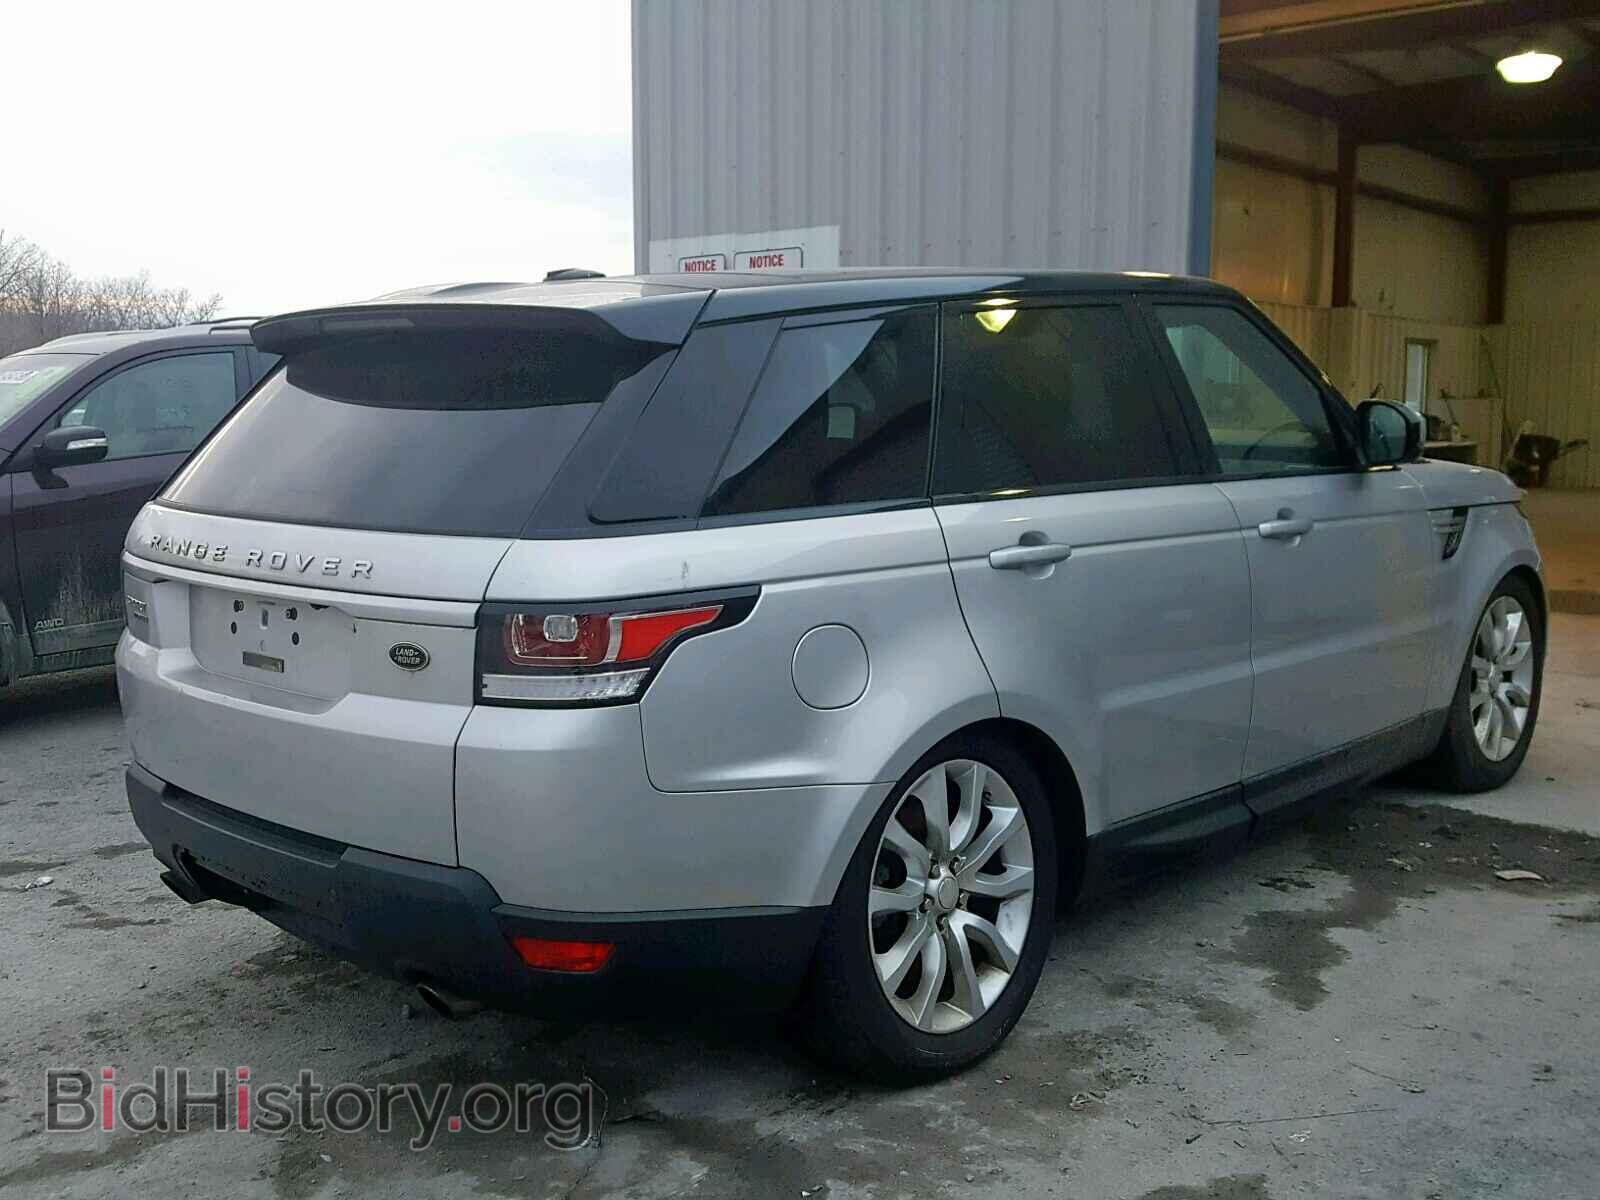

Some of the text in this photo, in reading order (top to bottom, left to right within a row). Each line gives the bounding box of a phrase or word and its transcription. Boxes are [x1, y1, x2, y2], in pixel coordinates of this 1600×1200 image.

[685, 260, 716, 272] NOTICE
[749, 254, 784, 269] NOTICE
[149, 534, 374, 579] RANGE ROVER
[34, 618, 64, 631] AWD
[395, 648, 414, 656] LAND
[397, 656, 420, 664] ROVER
